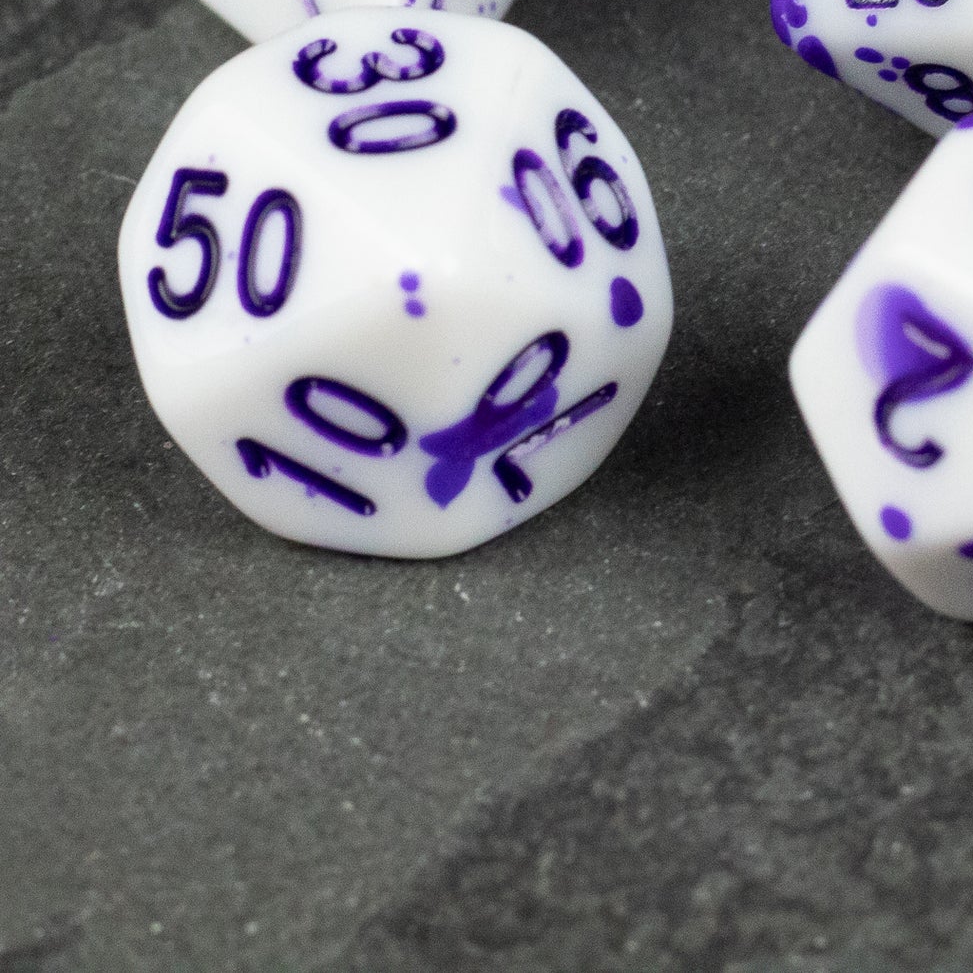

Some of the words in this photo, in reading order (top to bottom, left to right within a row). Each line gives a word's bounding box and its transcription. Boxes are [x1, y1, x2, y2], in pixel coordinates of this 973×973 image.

[293, 27, 458, 155] 30
[148, 168, 303, 320] 50
[236, 377, 408, 516] 10
